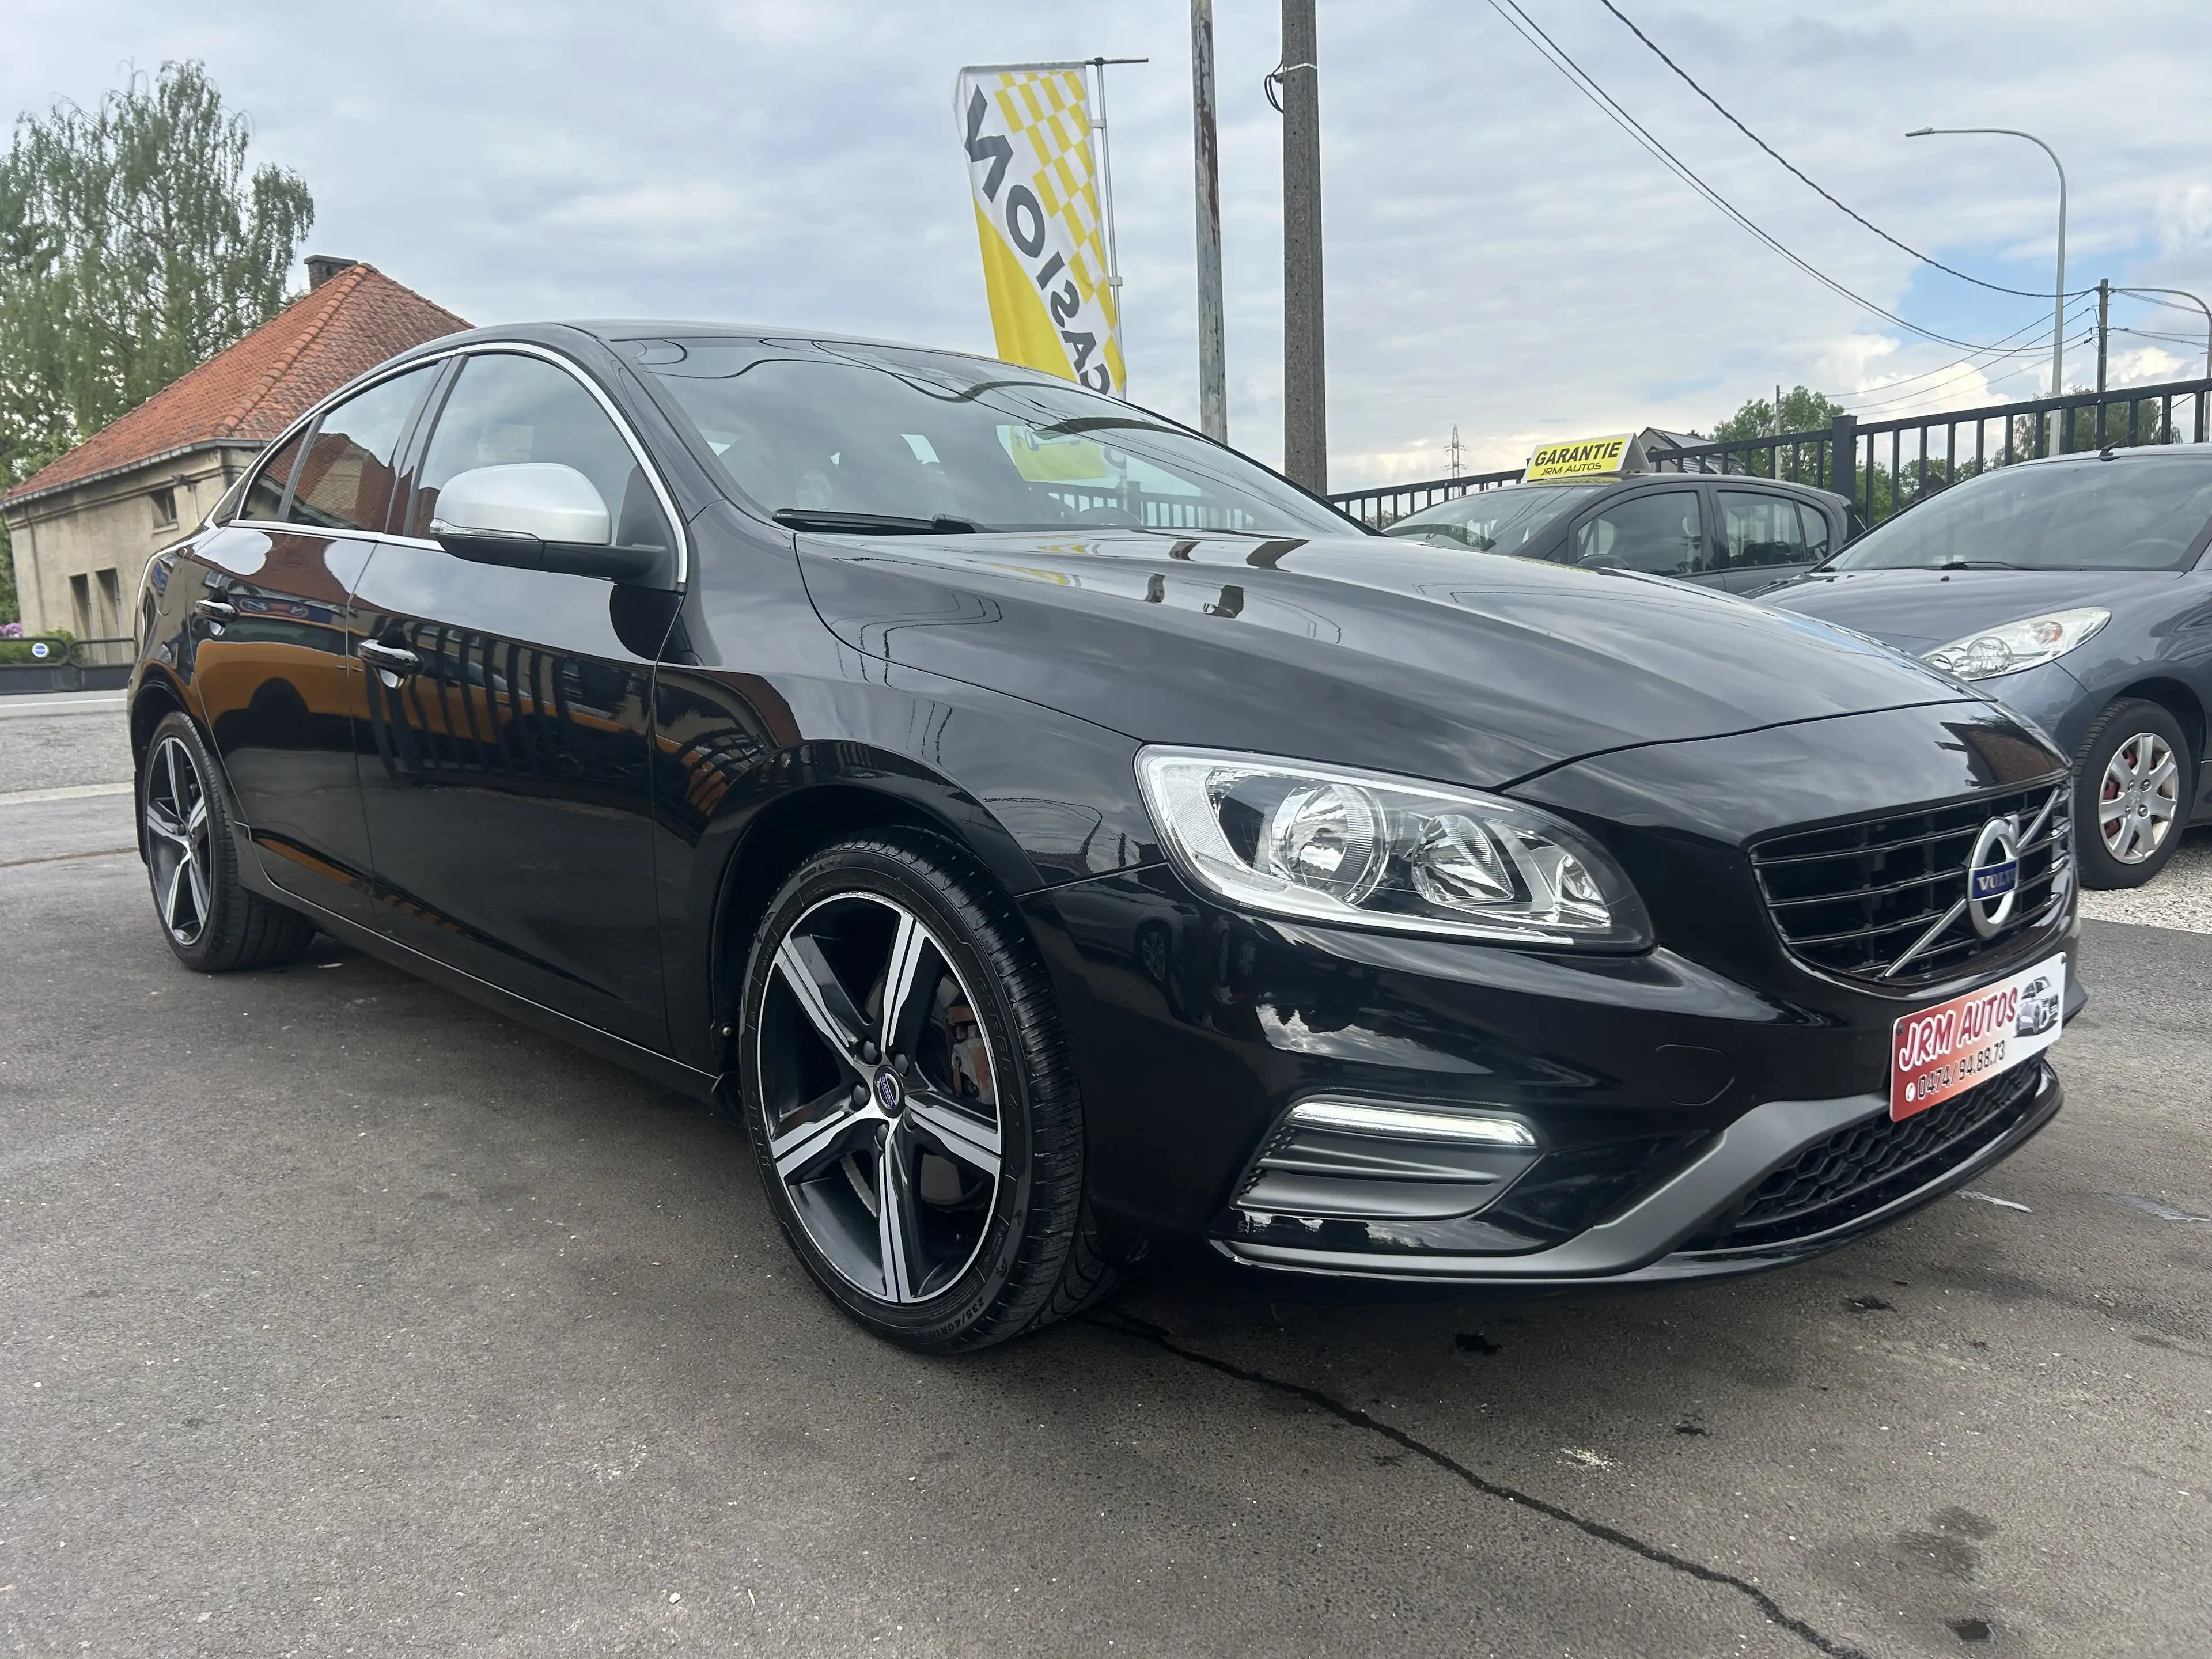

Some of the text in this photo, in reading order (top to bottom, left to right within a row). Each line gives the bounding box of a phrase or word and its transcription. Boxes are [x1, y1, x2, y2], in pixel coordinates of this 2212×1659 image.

[1535, 441, 1622, 467] GARANTIE
[1540, 462, 1601, 476] JRM AUTOS
[1899, 986, 2018, 1072] JRM AUTOS
[881, 1075, 894, 1107] VOLVO
